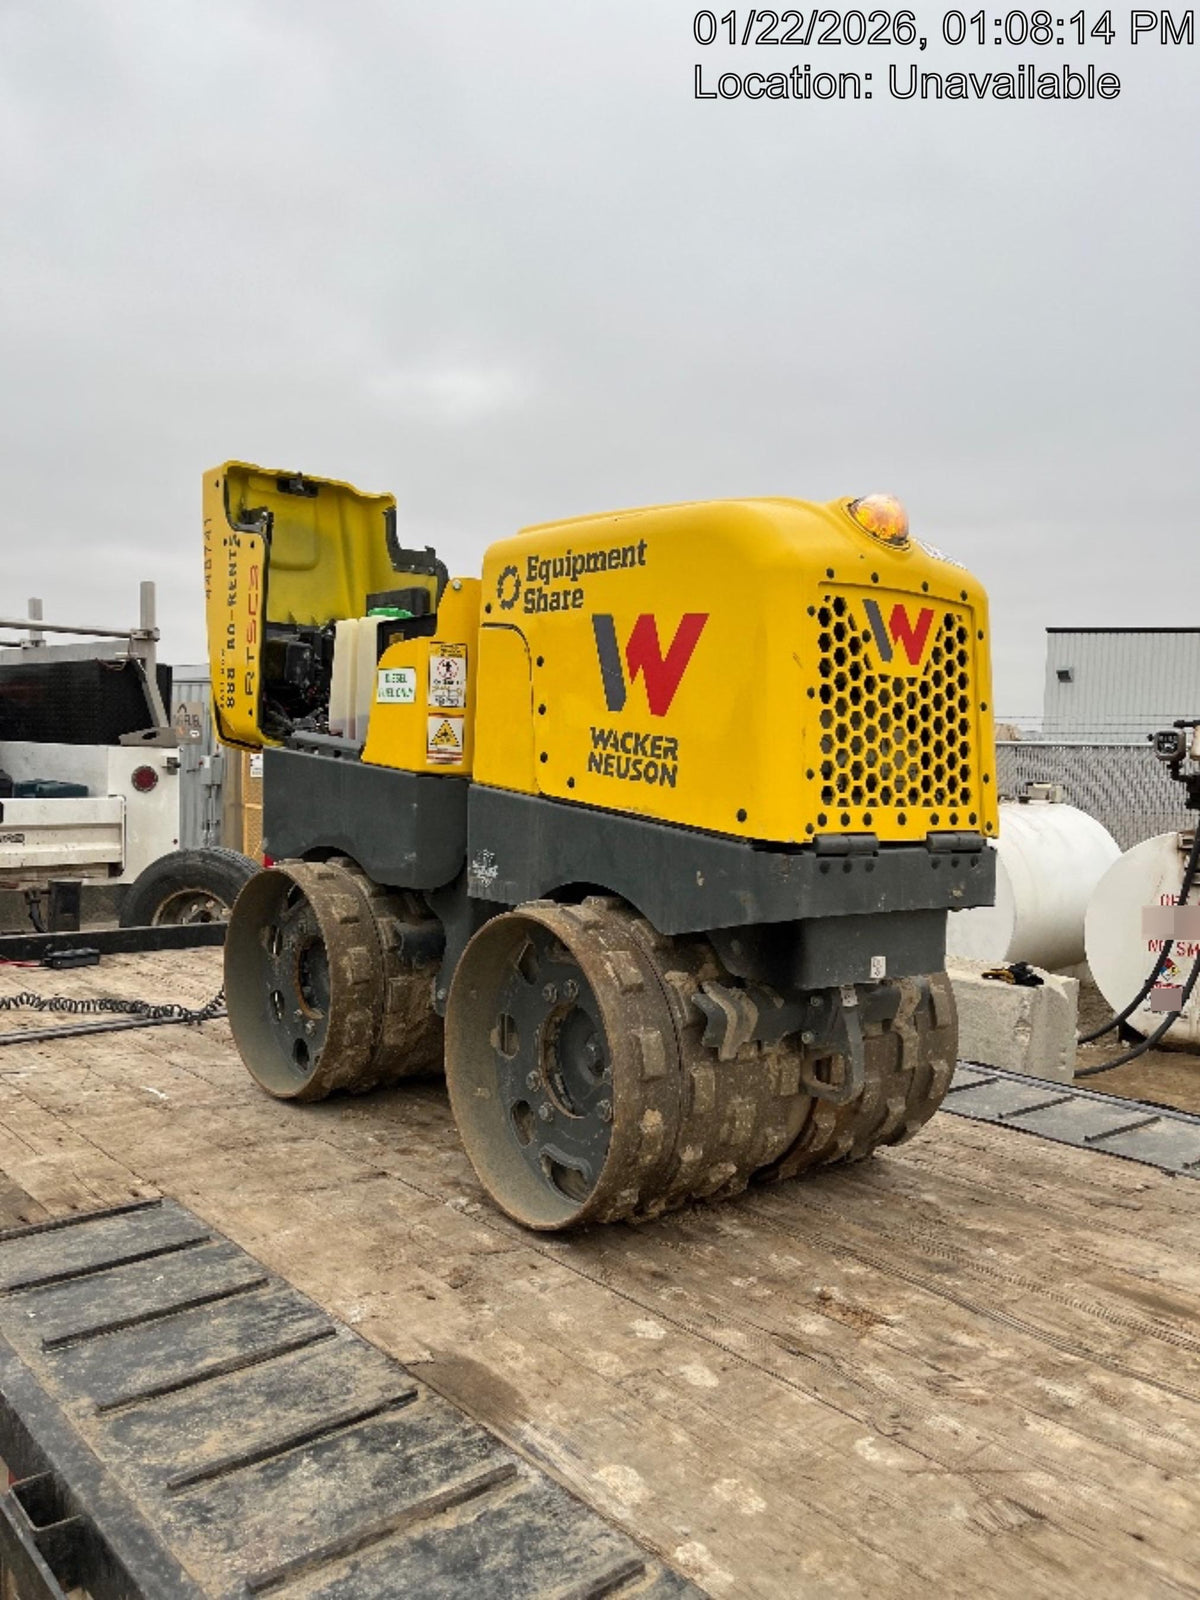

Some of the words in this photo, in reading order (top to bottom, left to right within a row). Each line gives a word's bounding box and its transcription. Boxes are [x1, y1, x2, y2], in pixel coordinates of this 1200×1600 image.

[525, 538, 648, 586] Equipment
[523, 587, 584, 614] Share
[589, 726, 679, 762] WACKER
[587, 751, 679, 789] NEUSON
